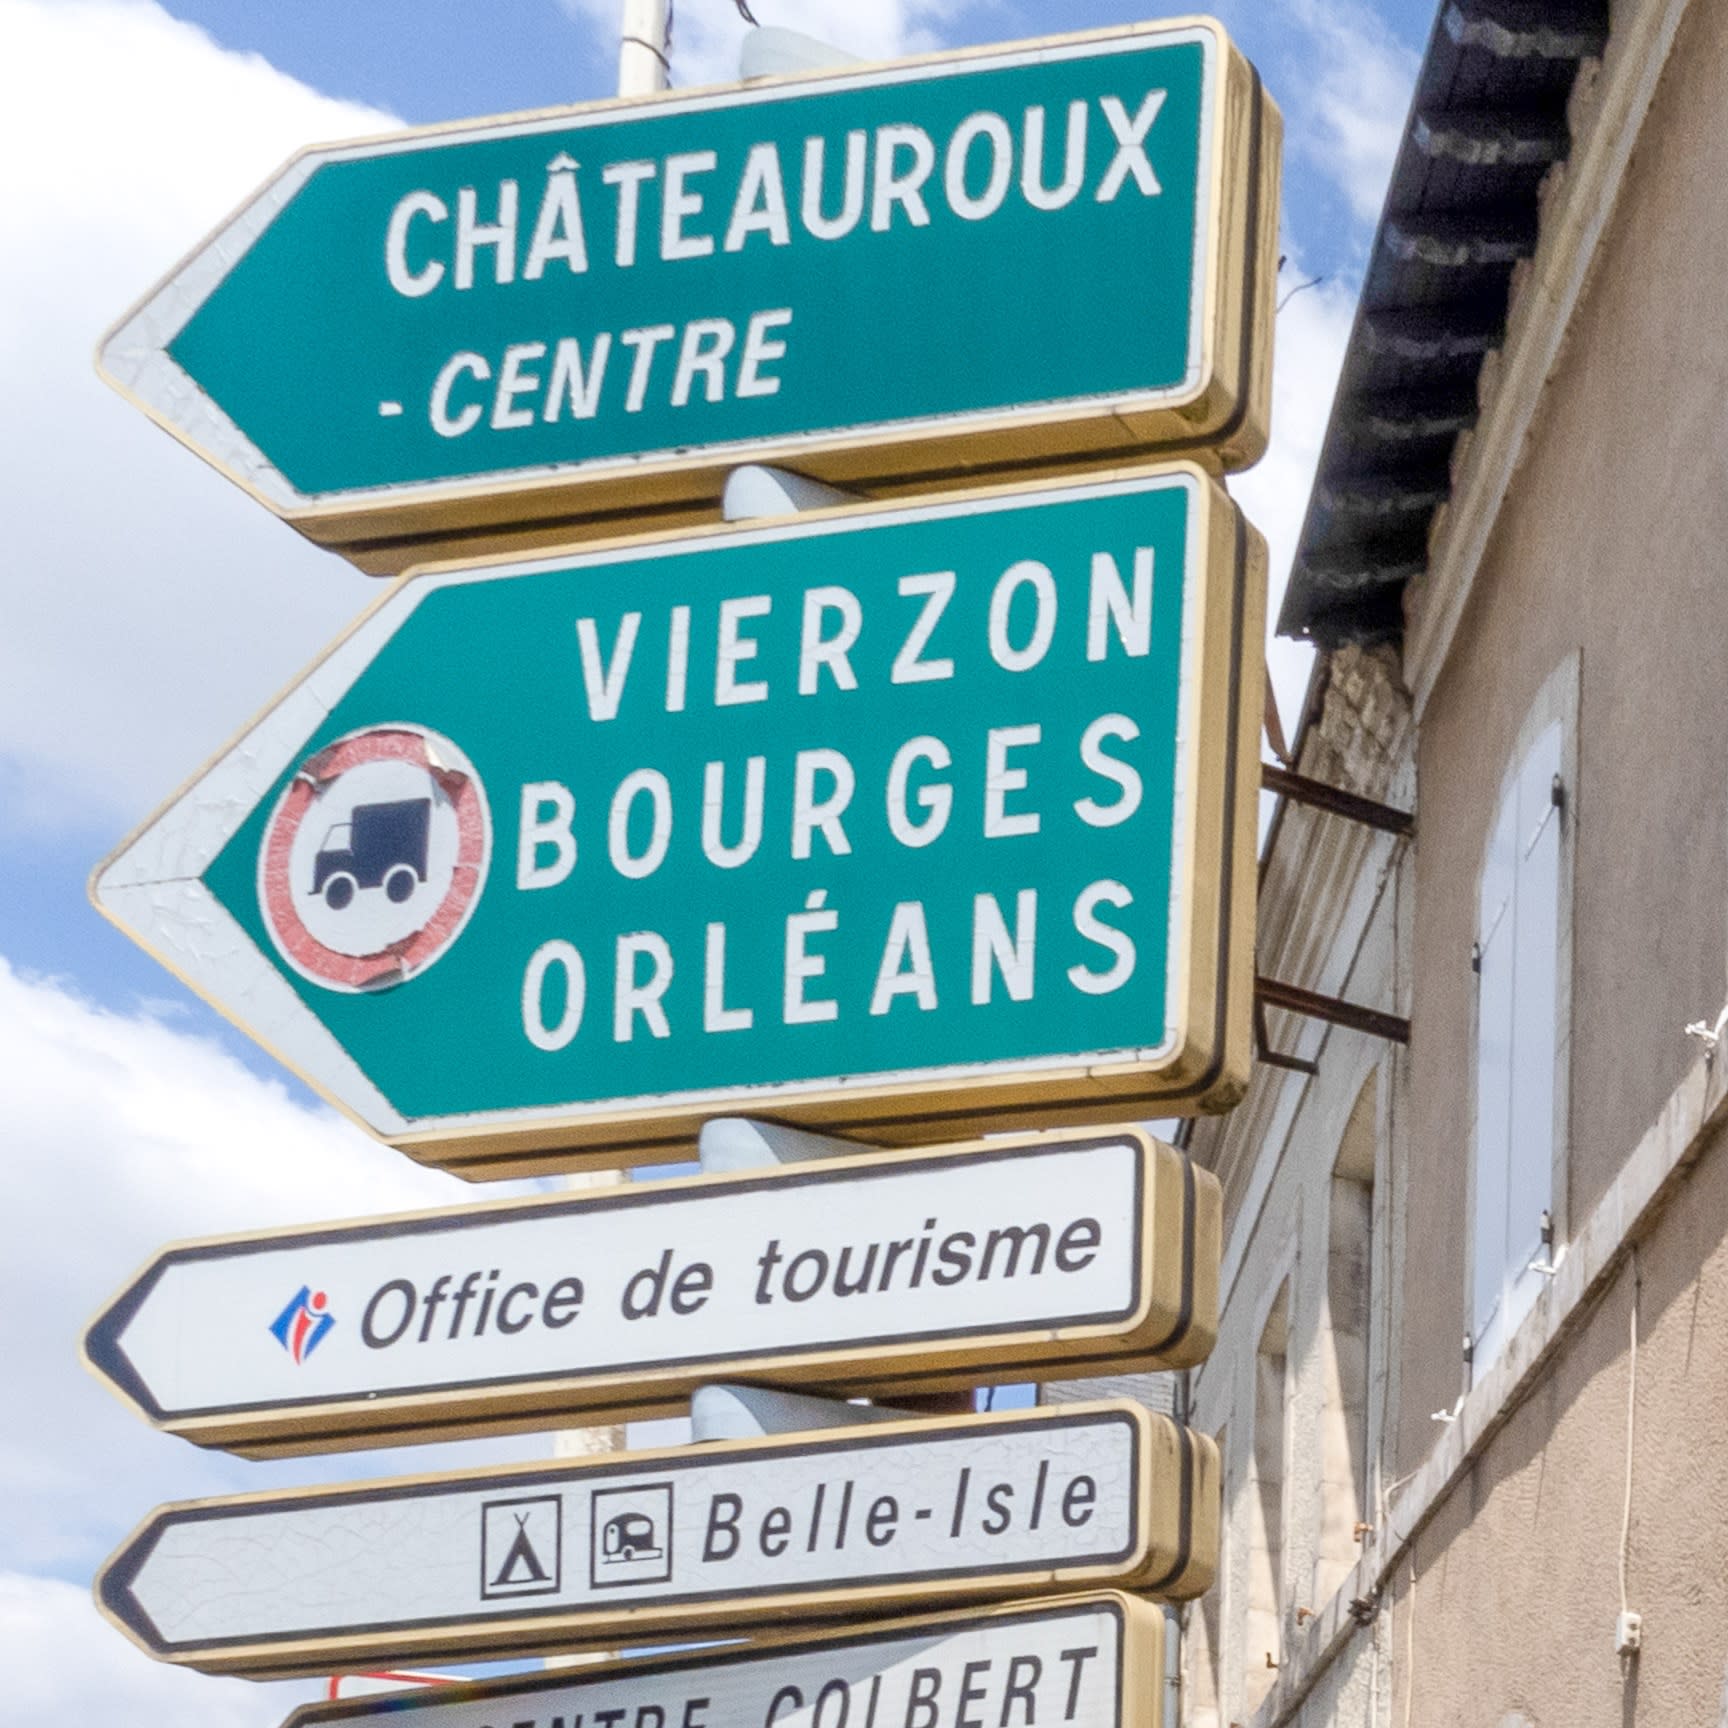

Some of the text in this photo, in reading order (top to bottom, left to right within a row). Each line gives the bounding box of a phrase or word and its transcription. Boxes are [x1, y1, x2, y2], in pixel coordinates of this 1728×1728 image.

[384, 87, 1167, 298] CHÂTEAUROUX
[429, 309, 792, 439] CENTRE
[576, 545, 1155, 723] VIERZON
[516, 713, 1143, 892] BOURGES
[520, 880, 1137, 1051] ORLÉANS
[359, 1214, 1102, 1351] Office de tourisme
[701, 1461, 1097, 1563] Belle-Isle
